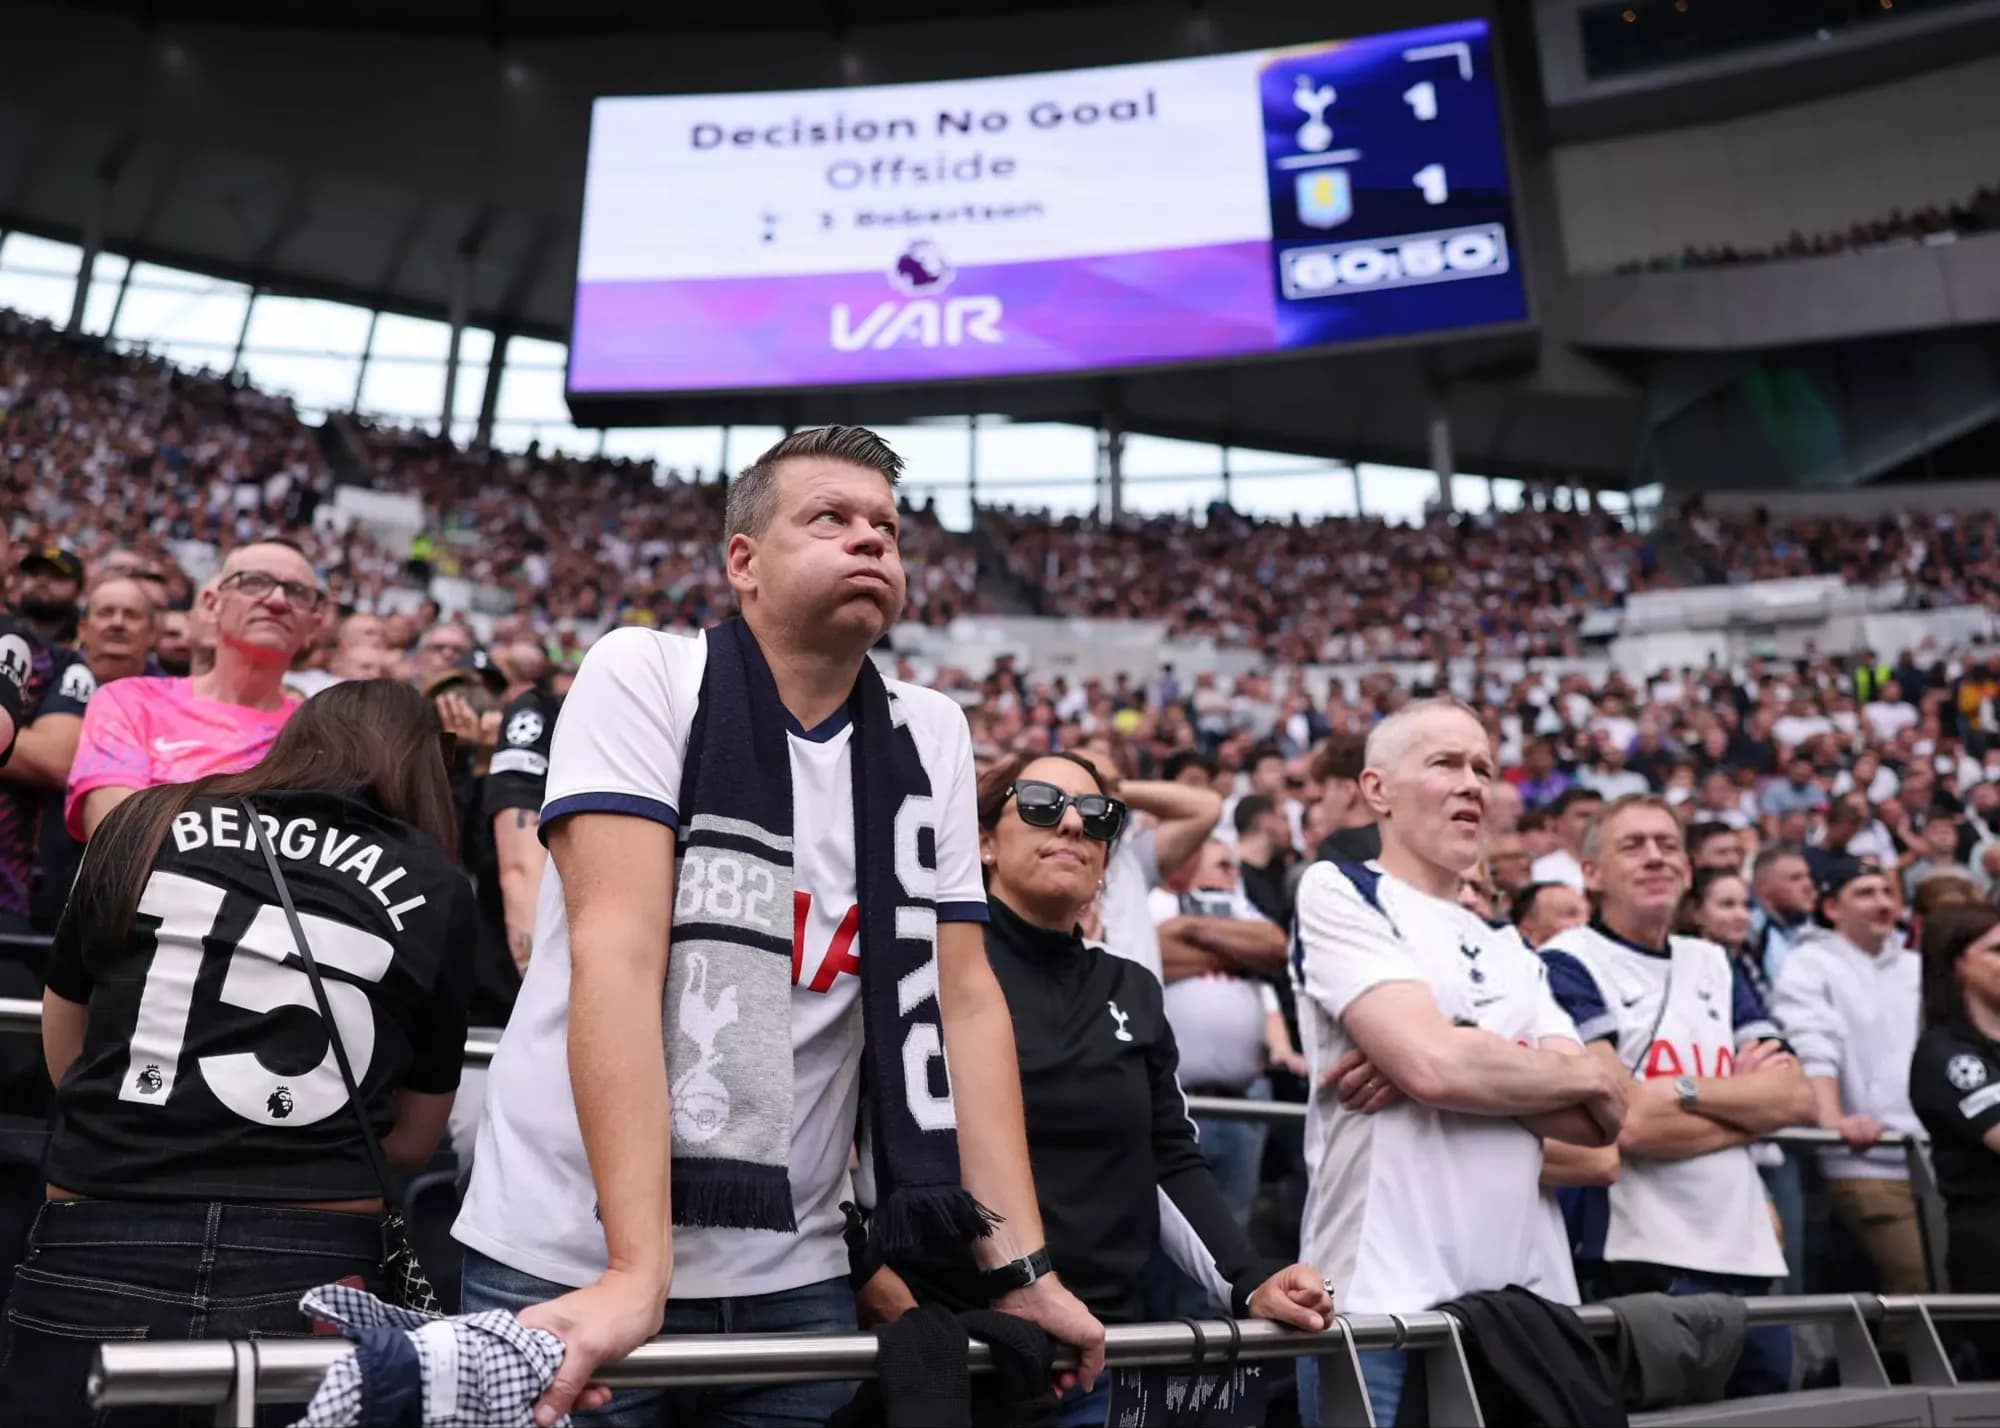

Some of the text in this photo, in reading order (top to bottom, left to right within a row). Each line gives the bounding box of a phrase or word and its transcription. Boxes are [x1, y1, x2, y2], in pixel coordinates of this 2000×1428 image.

[691, 89, 1156, 150] Decision No Goal
[1403, 80, 1438, 121] 1
[826, 151, 1016, 191] Offside
[1412, 163, 1448, 205] 1
[830, 294, 1006, 351] VAR
[171, 806, 427, 932] BERGVALL
[118, 870, 395, 1127] 15
